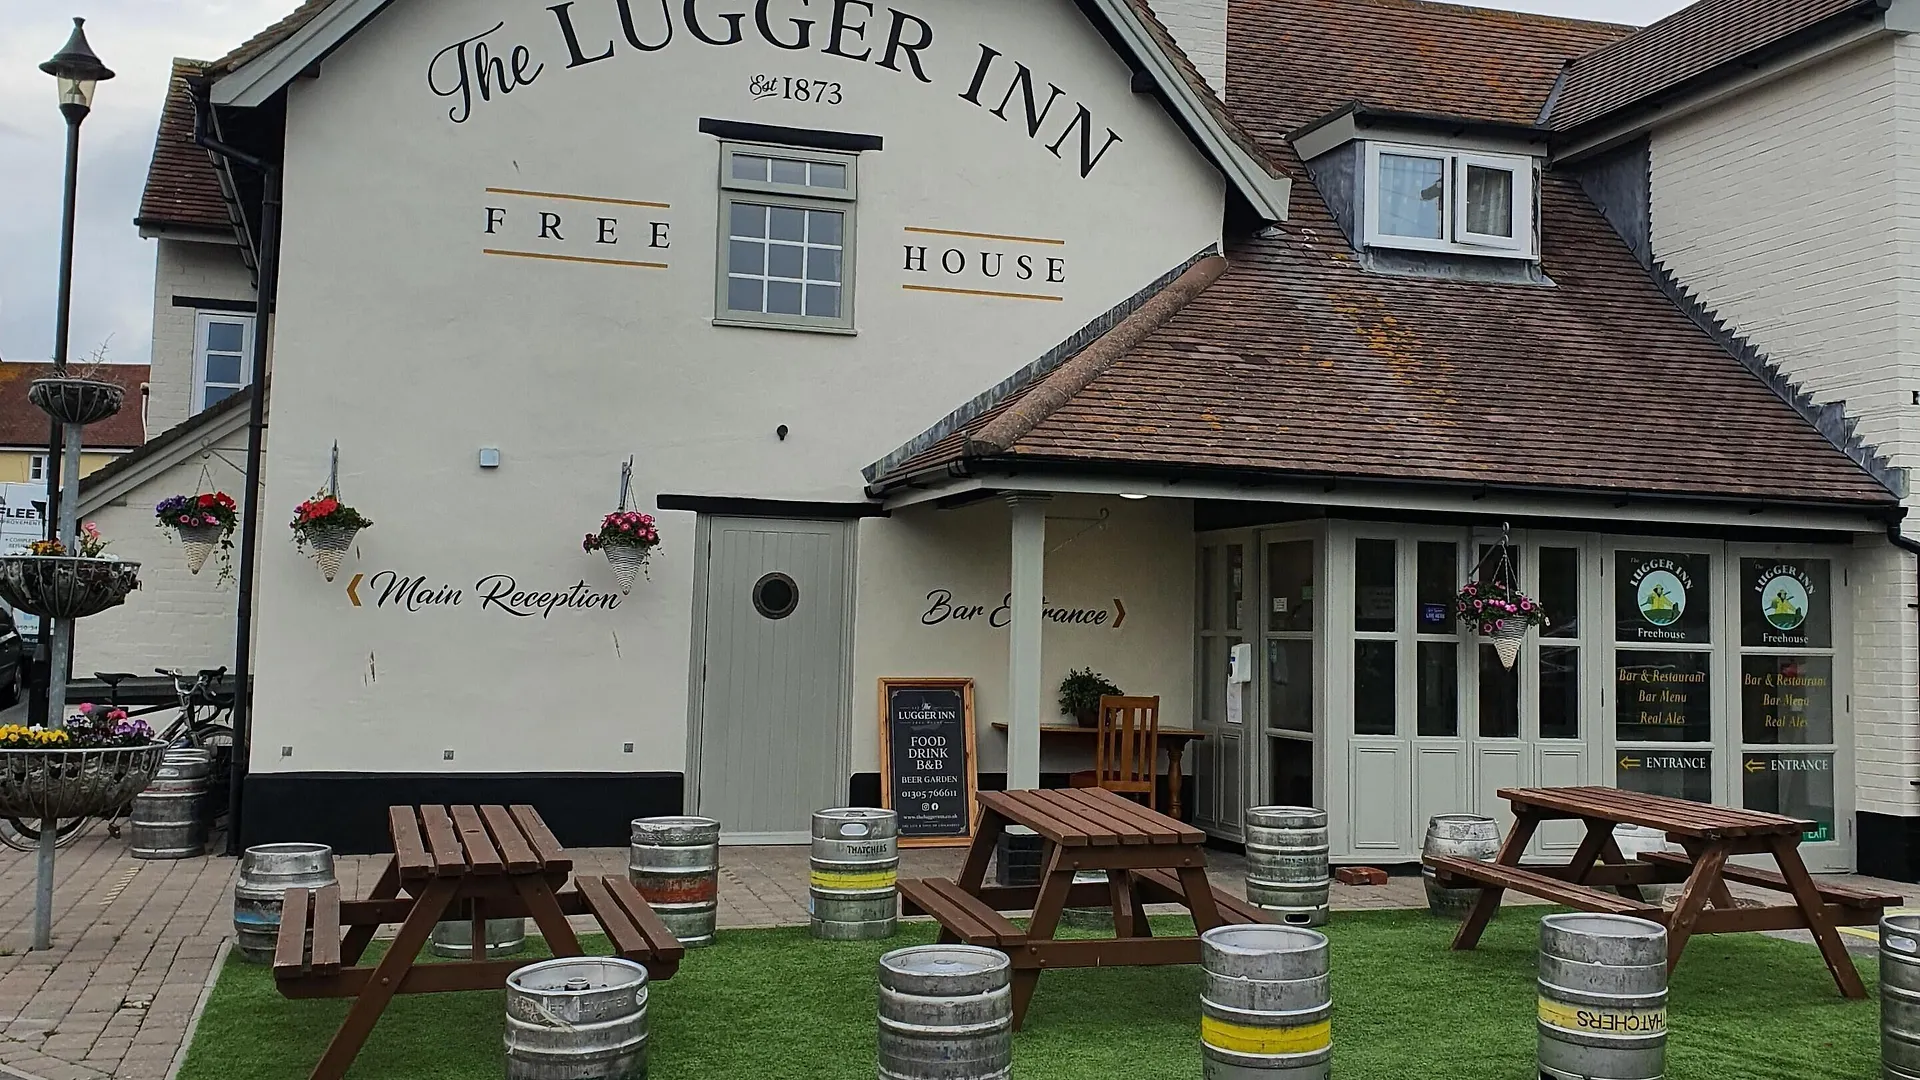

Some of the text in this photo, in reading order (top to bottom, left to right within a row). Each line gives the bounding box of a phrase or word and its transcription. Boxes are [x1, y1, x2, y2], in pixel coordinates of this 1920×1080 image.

[427, 0, 1124, 180] The LUGGER INN
[749, 74, 843, 105] Est 1873
[484, 205, 672, 250] FREE
[903, 244, 1067, 285] HOUSE
[1629, 558, 1694, 590] LUGGER INN
[1754, 564, 1816, 595] LUGGER INN
[370, 570, 622, 619] Main Reception
[921, 589, 1109, 628] Bar Erance
[1637, 627, 1686, 640] Freehouse
[1763, 632, 1810, 645] Freehouse
[1619, 669, 1706, 684] Bar & Restaurant
[1744, 673, 1827, 687] Bar & Restaurant
[1638, 689, 1687, 703] Bar Menu
[1763, 693, 1781, 706] Bar
[898, 711, 956, 720] LUGGER INN
[1640, 711, 1686, 725] Real Ales
[1765, 714, 1808, 728] Real Ales
[910, 736, 947, 747] FOOD
[908, 748, 949, 759] DRINK
[916, 760, 944, 770] B&B
[1646, 757, 1706, 770] ENTRANCE
[1771, 759, 1829, 771] ENTRANCE
[901, 775, 958, 784] BEER GARDEN
[901, 788, 957, 799] 01305 766611
[1808, 827, 1828, 839] EXIT
[846, 844, 888, 855] THATCHERS
[1576, 1010, 1666, 1031] THATCHERS
